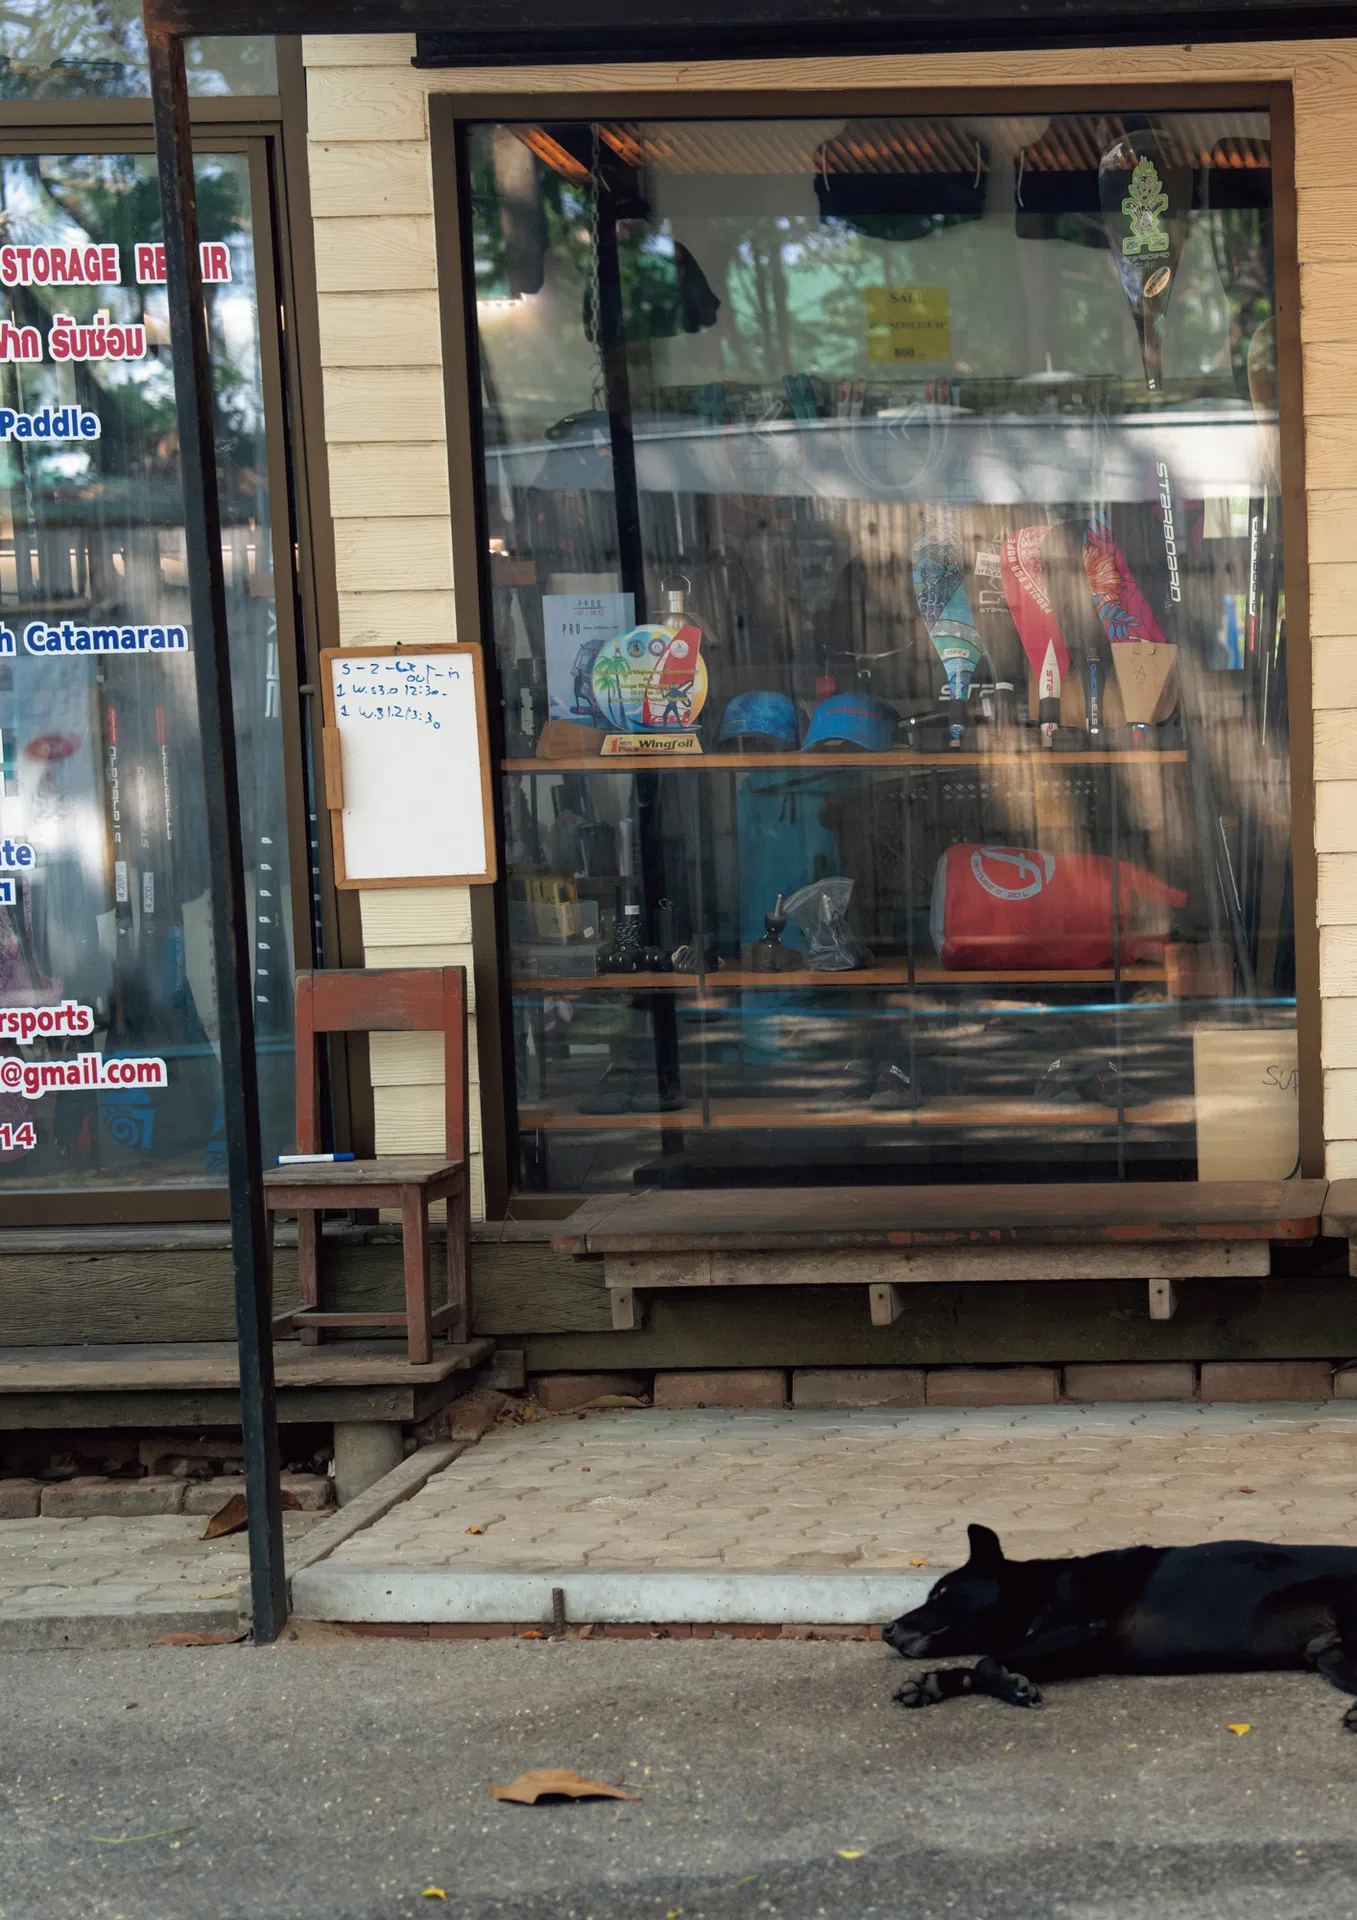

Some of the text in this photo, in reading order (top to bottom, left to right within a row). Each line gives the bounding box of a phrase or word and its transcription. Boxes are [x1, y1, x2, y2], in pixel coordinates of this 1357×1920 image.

[1, 246, 229, 282] STORAGE REIR
[52, 317, 144, 359] รับซ่อม
[0, 408, 97, 437] Paddle
[27, 624, 185, 651] Catamaran
[0, 1056, 162, 1094] @gmail.com
